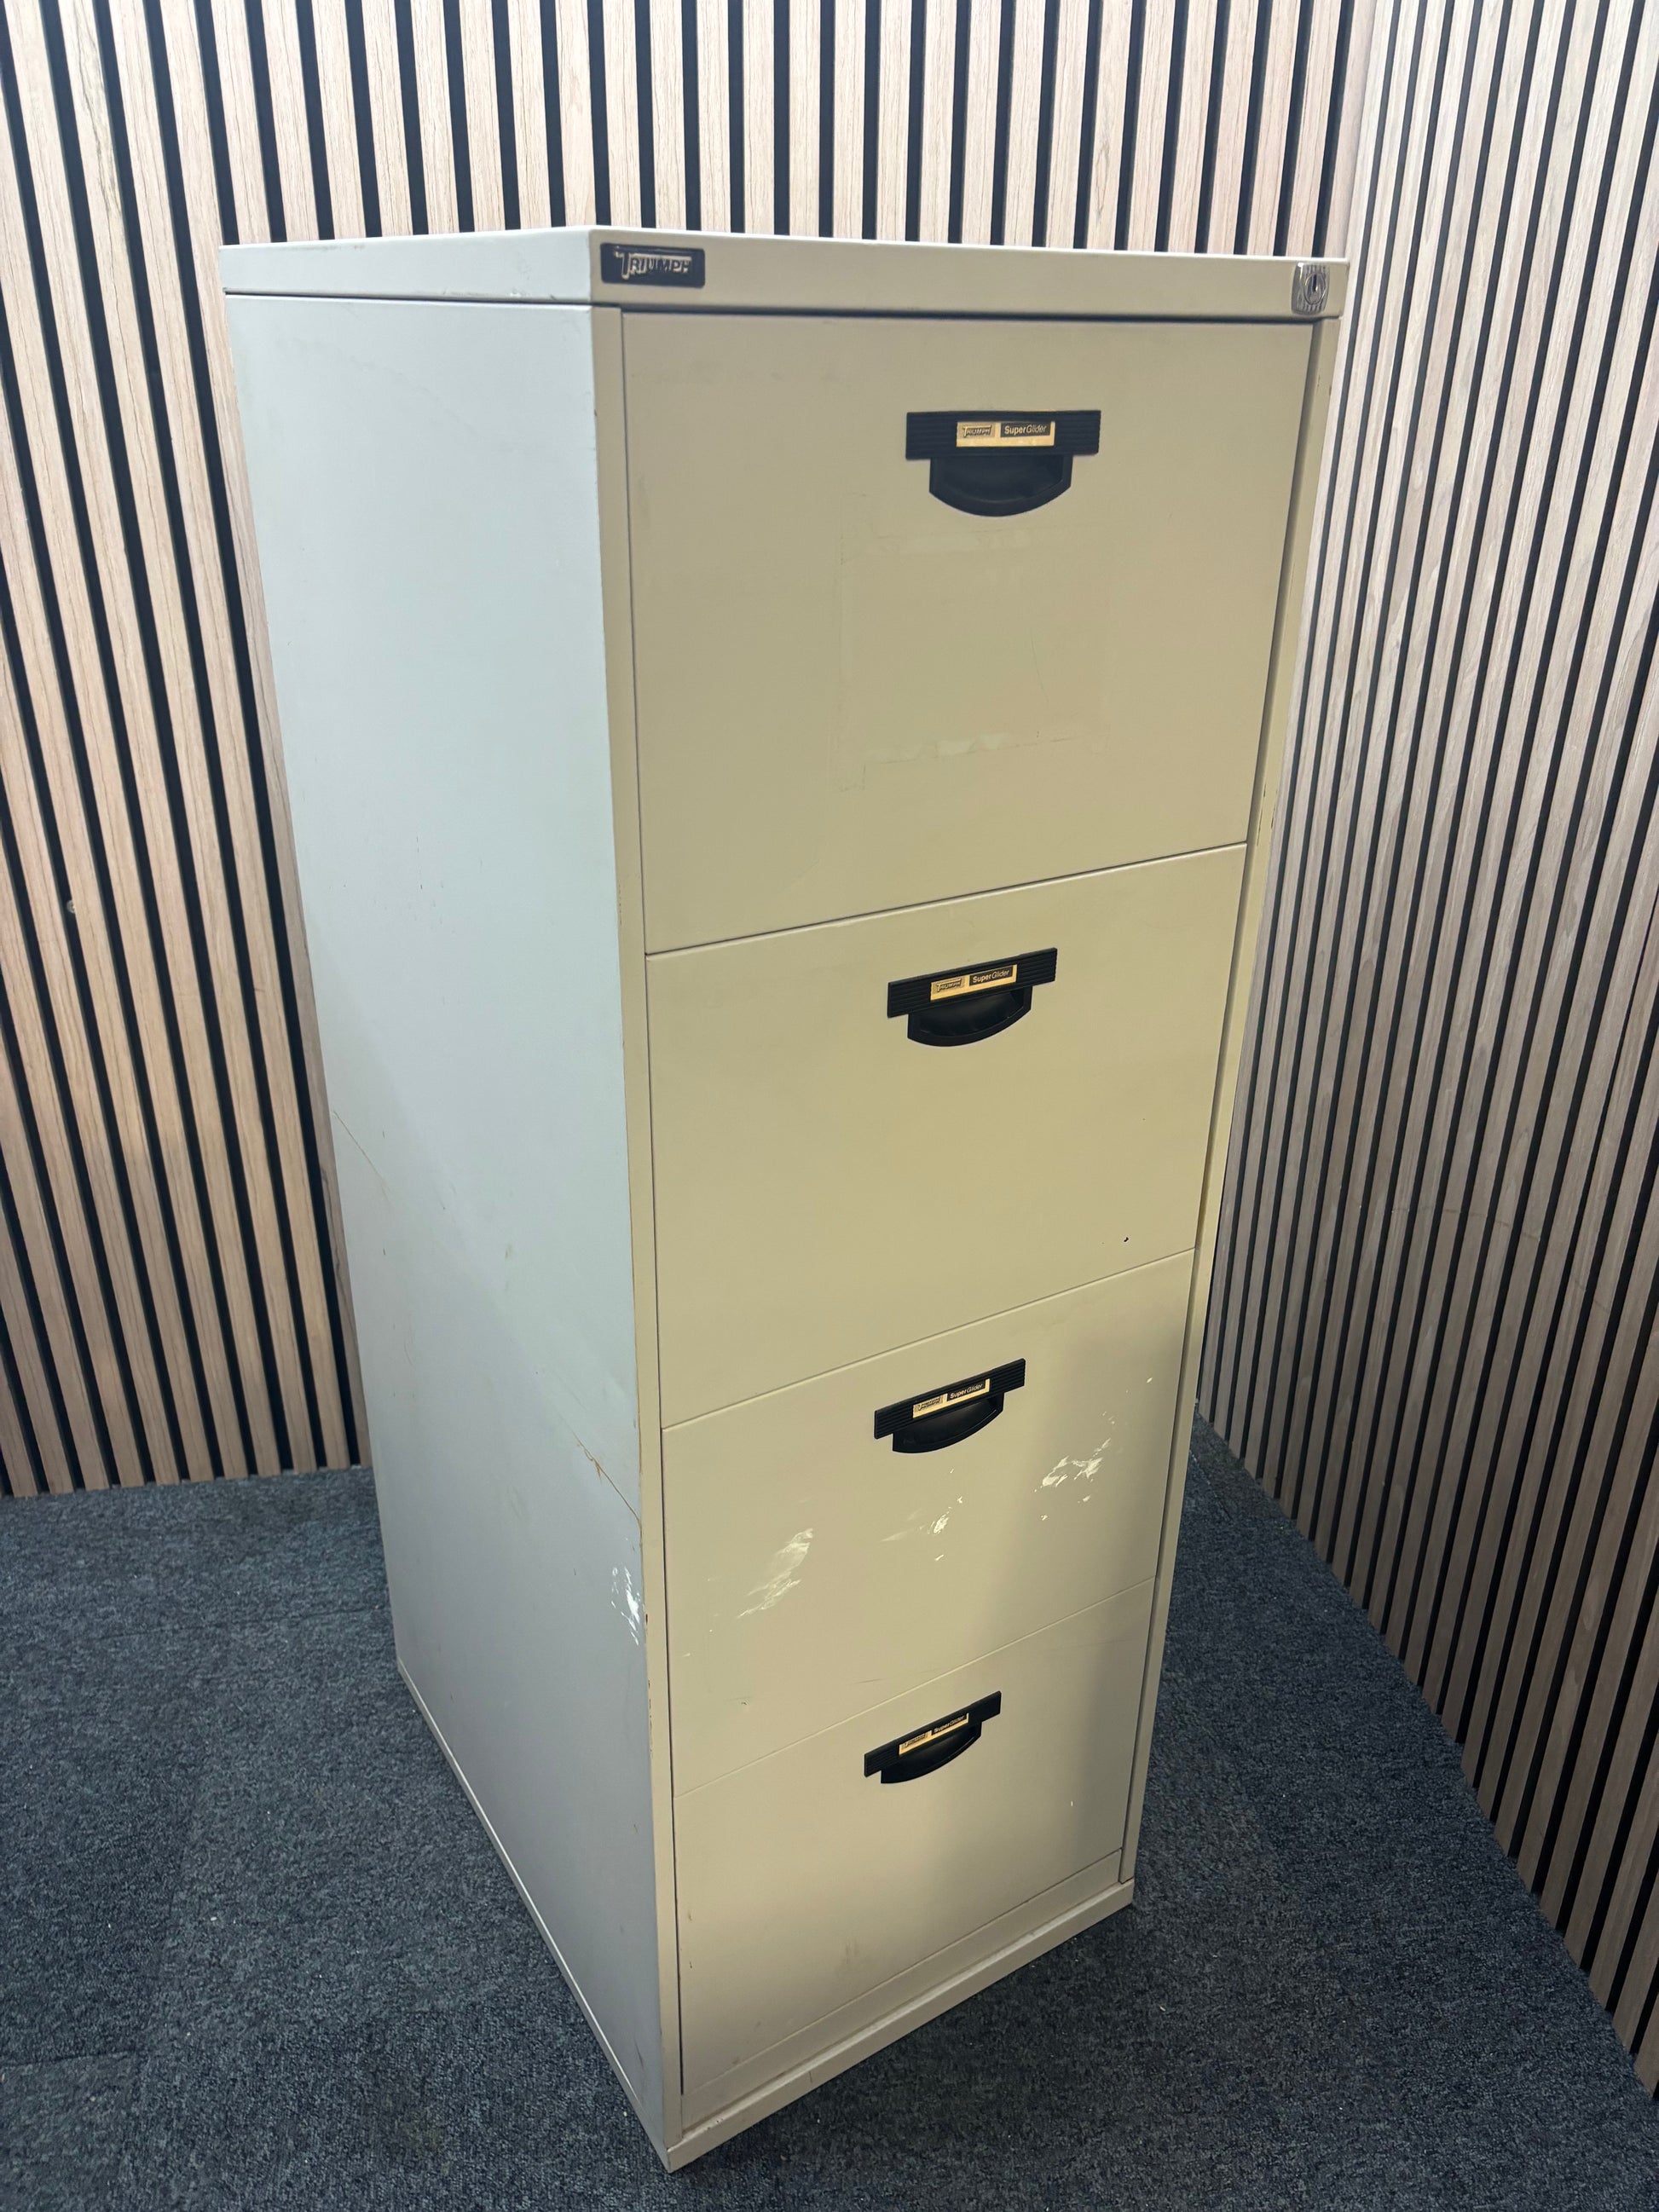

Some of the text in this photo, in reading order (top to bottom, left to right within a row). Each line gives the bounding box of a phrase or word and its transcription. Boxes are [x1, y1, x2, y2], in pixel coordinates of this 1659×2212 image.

[615, 251, 692, 280] TRIUMPH
[962, 424, 1048, 438] TRIUMPH SuperGlider
[972, 969, 1010, 984] SuperGlider
